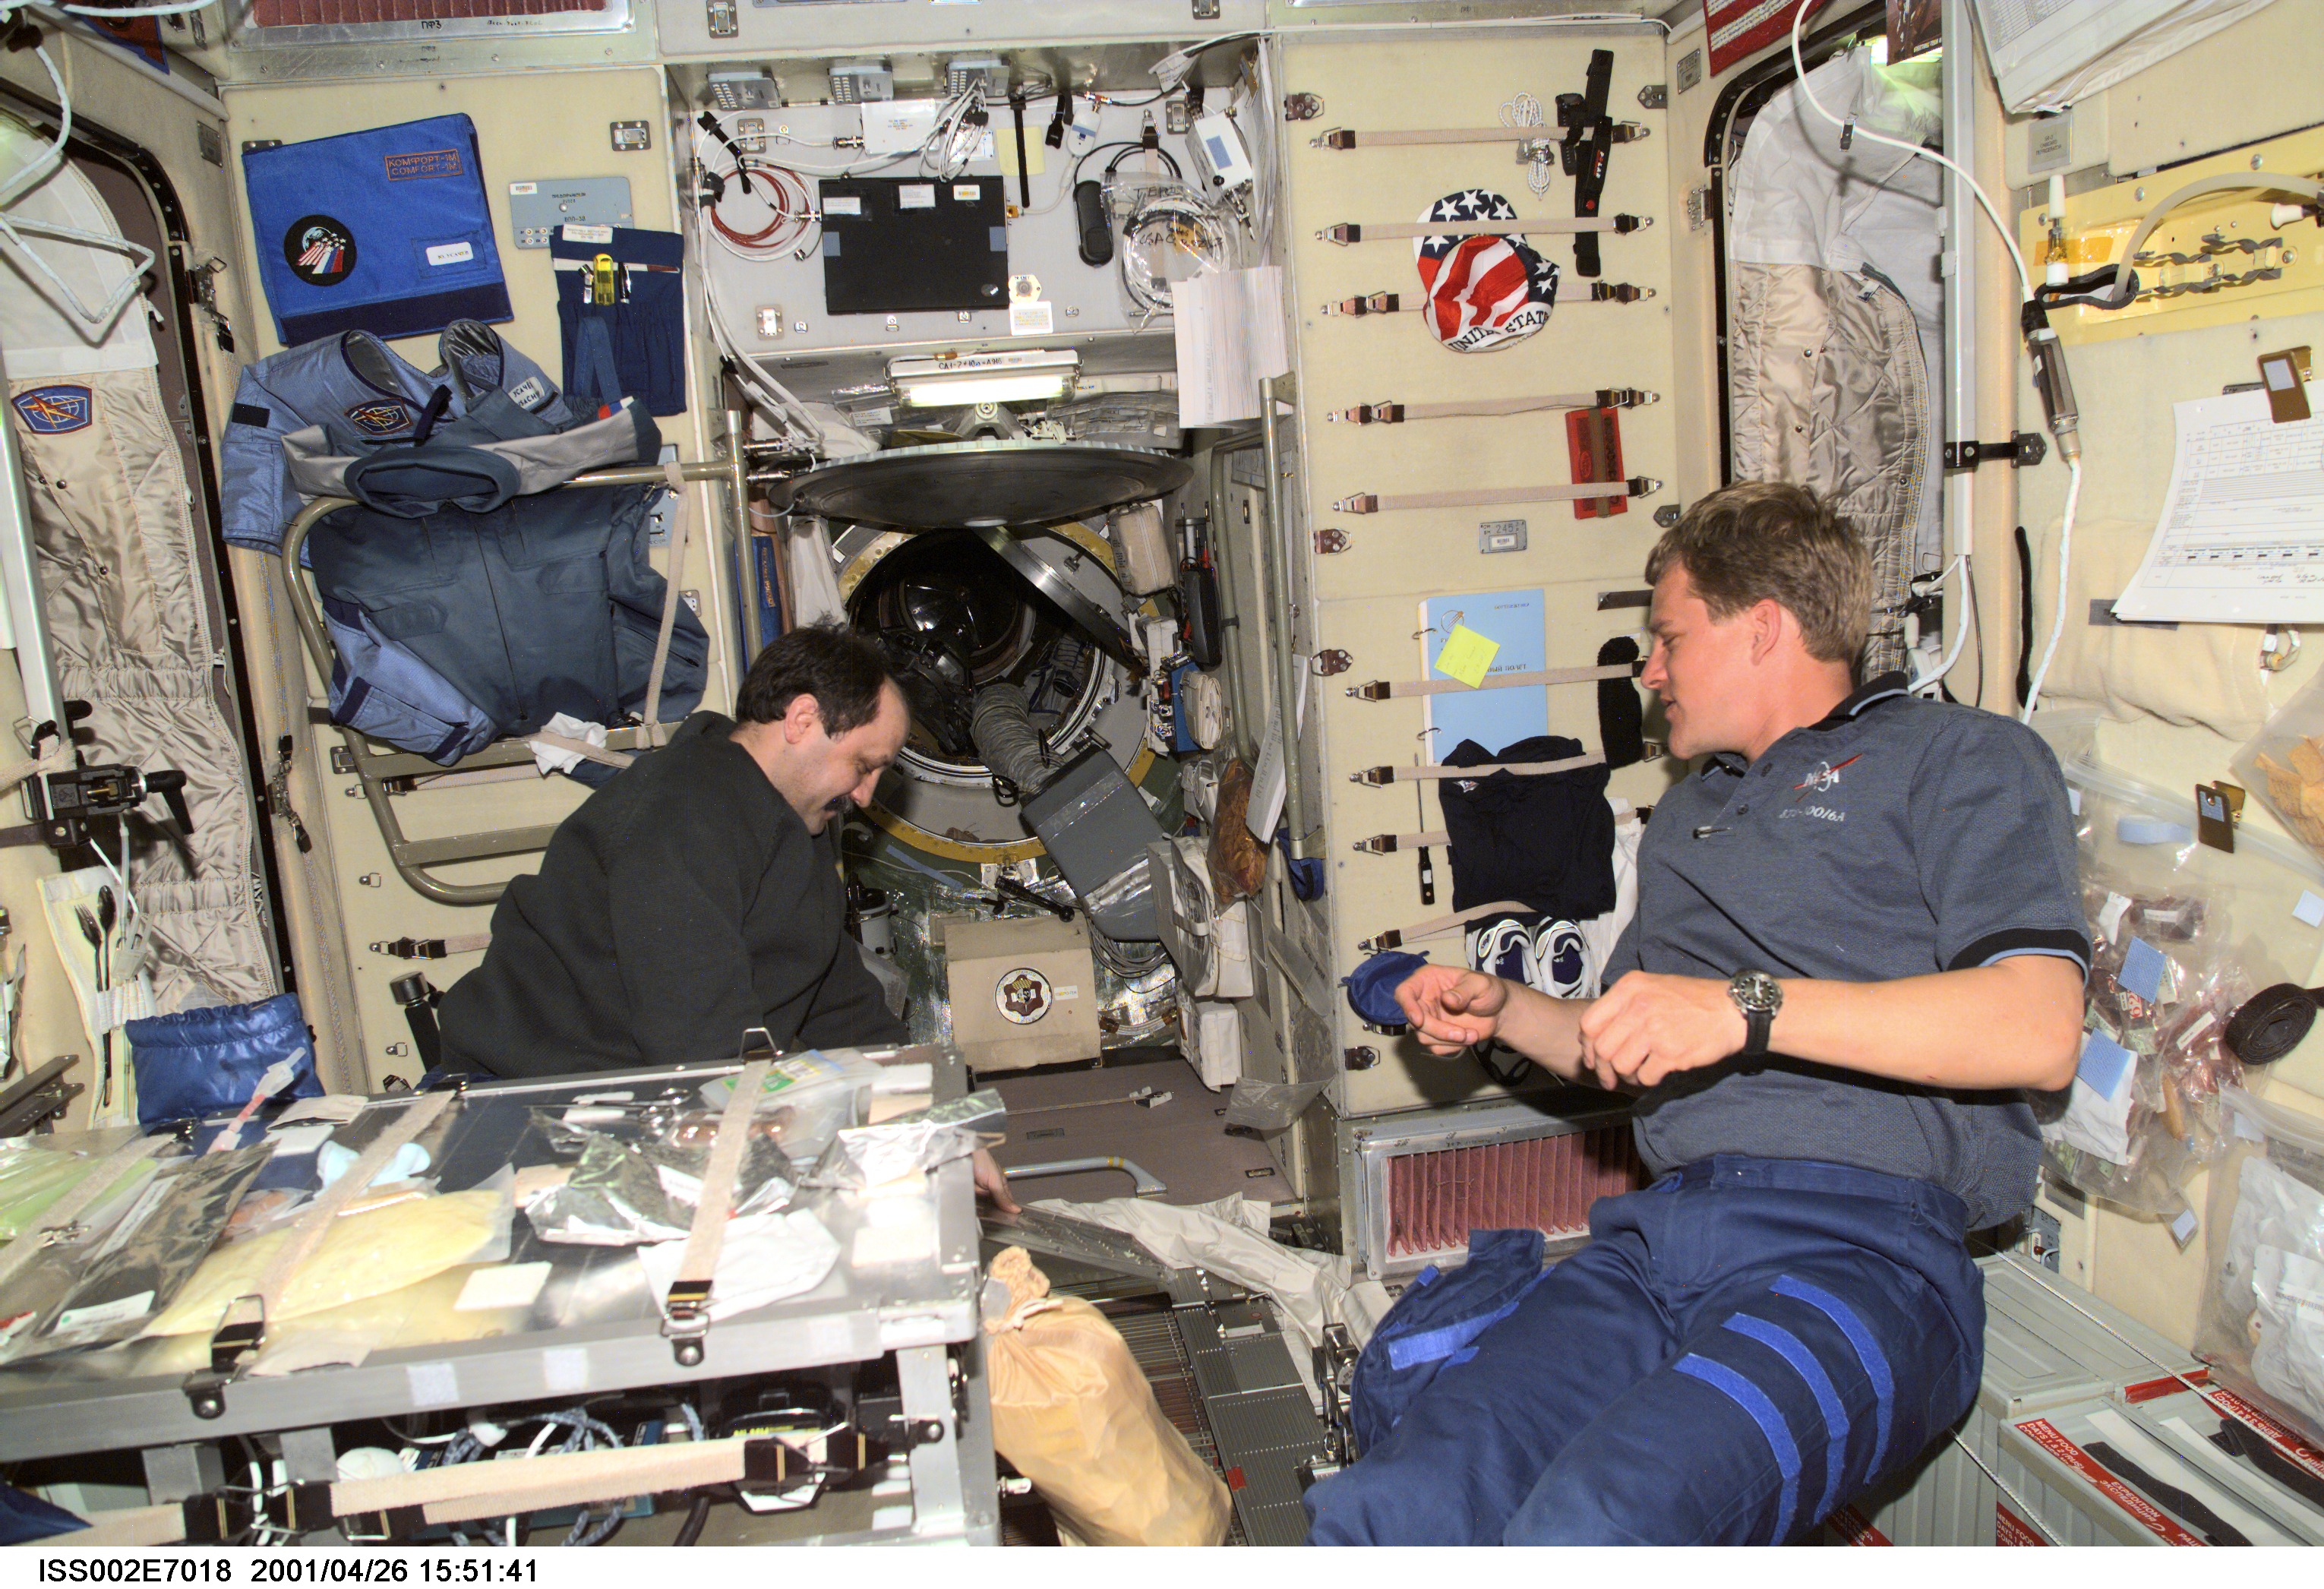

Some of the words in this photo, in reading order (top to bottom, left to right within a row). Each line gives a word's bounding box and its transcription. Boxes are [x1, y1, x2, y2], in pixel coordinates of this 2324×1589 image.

[2026, 1423, 2049, 1440] DAYS
[2035, 1420, 2059, 1439] MENU
[2056, 1437, 2079, 1456] FOOD
[2111, 1481, 2161, 1518] EXPEDITION
[1997, 1511, 2015, 1531] MENU
[2015, 1528, 2035, 1546] FOOD
[1997, 1520, 2013, 1539] DAYS
